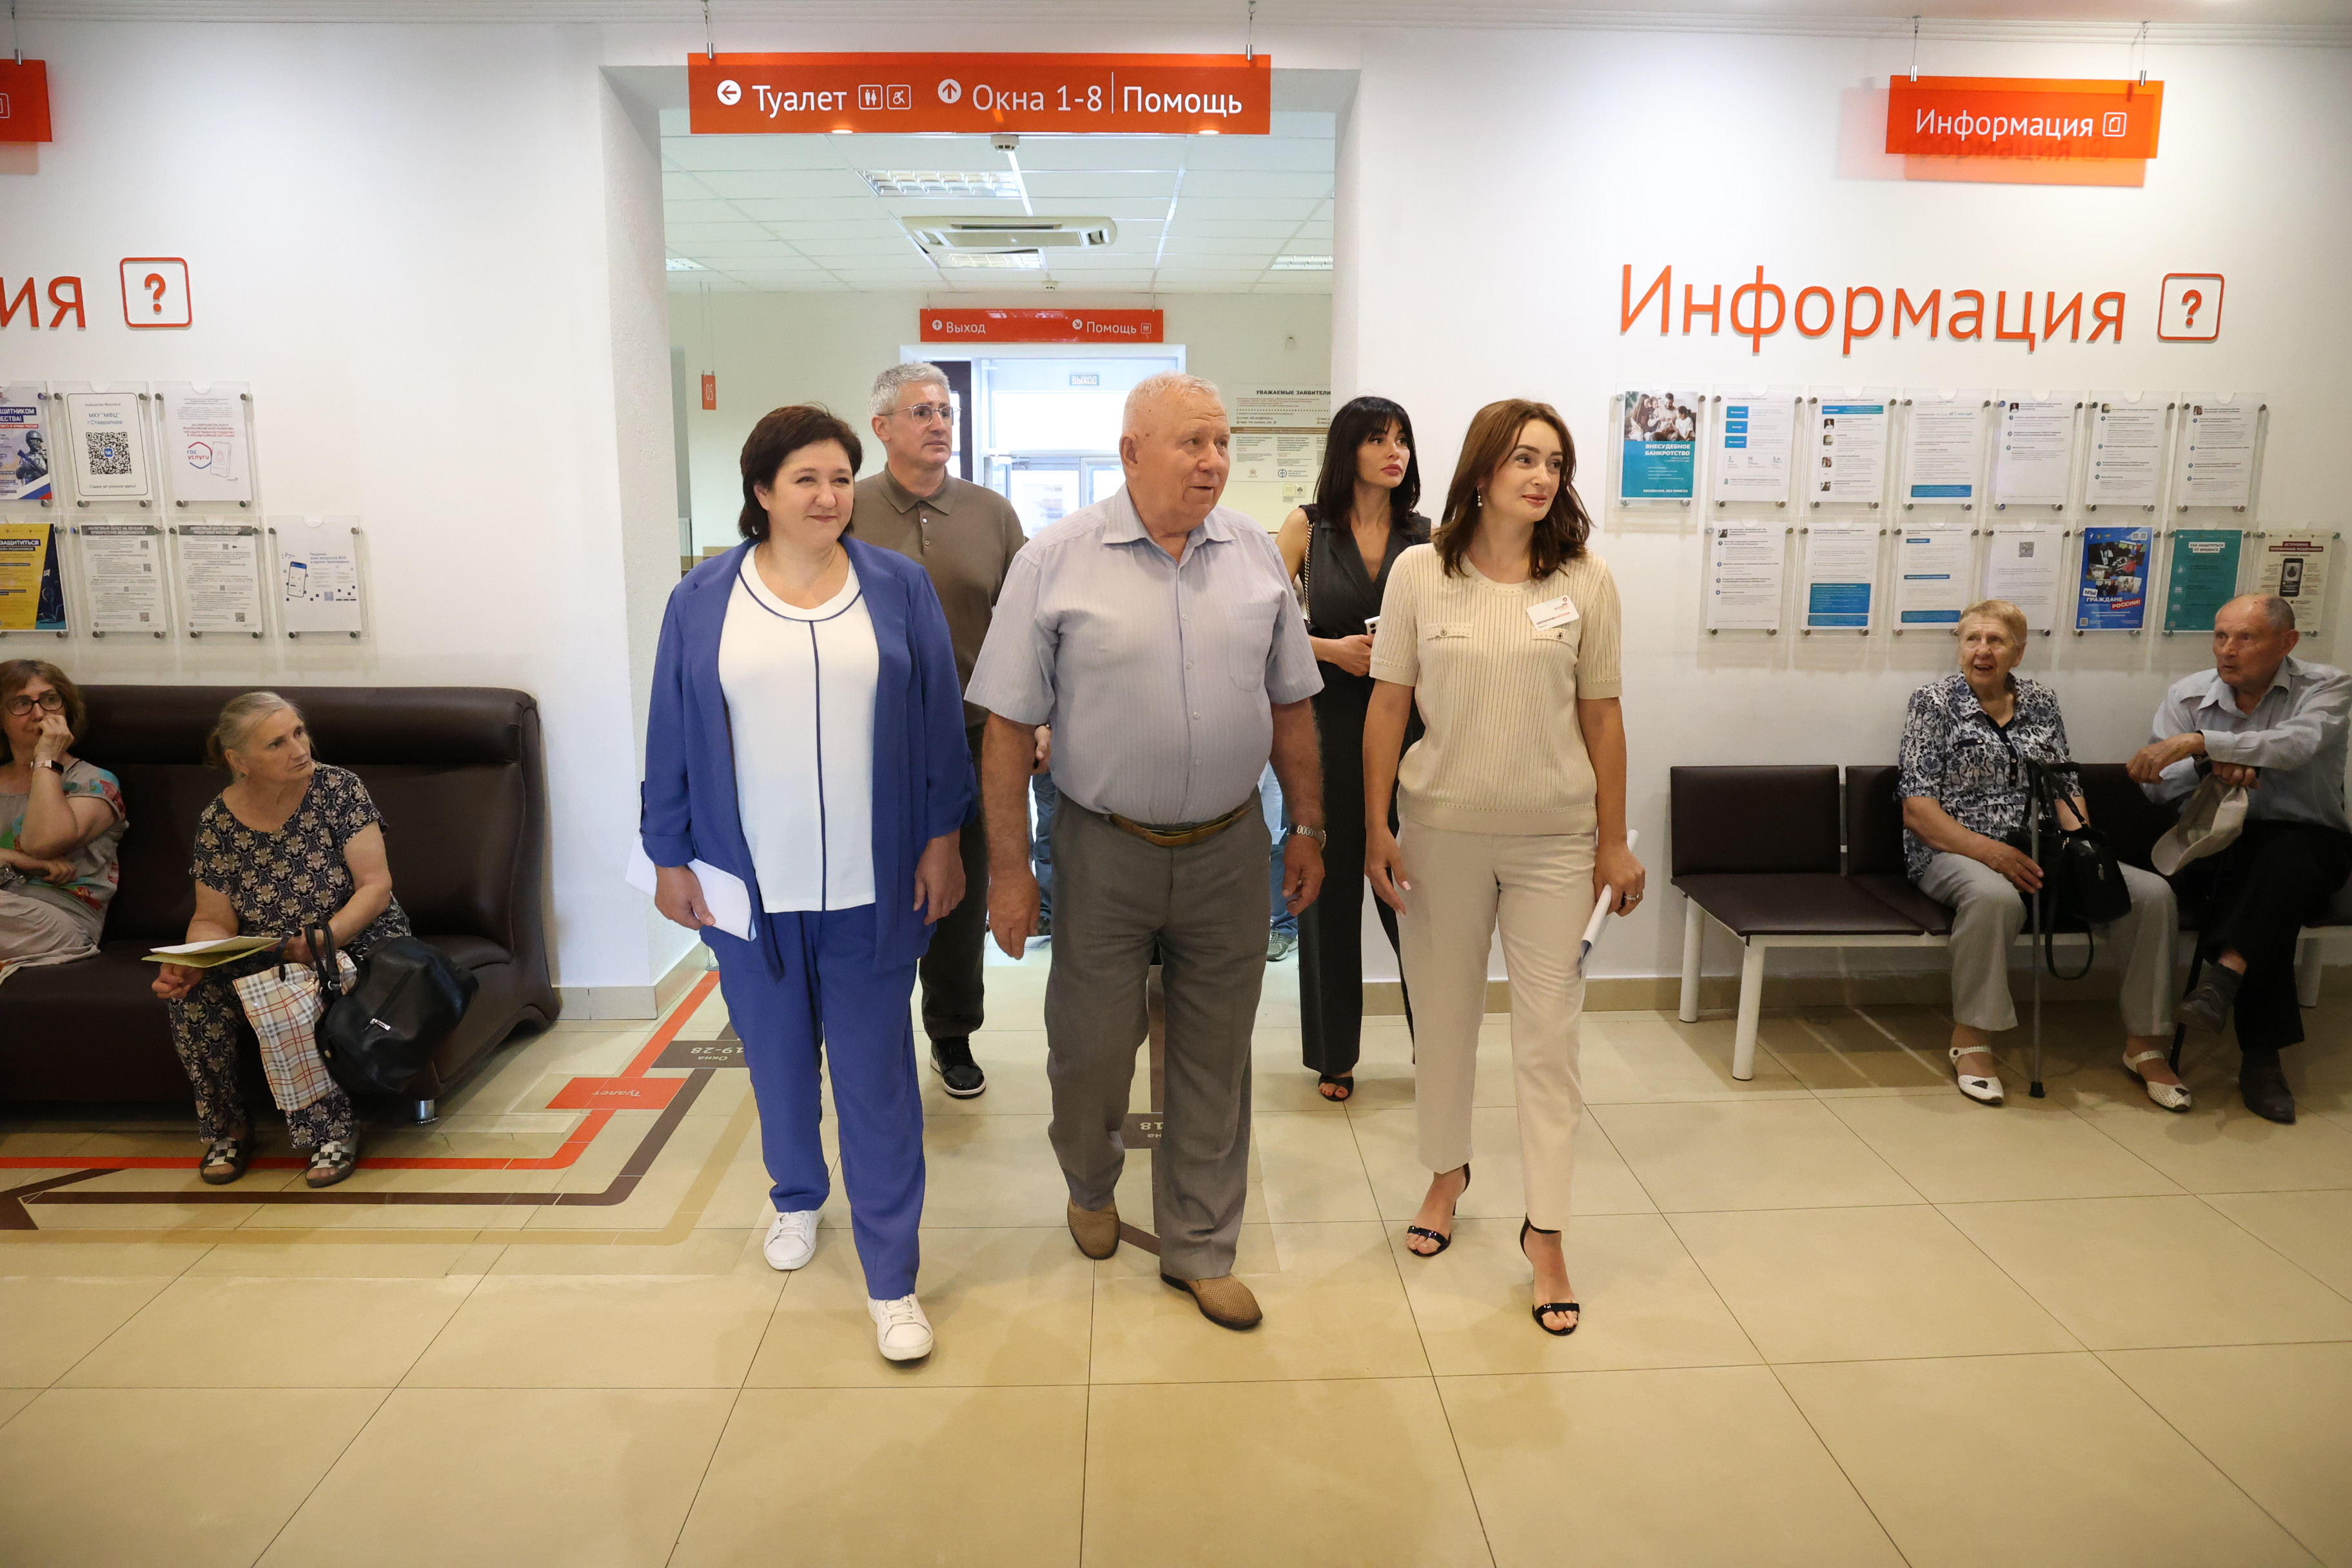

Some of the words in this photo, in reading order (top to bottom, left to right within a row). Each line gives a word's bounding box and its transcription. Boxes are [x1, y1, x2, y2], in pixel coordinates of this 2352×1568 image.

[752, 85, 847, 119] Туалет
[974, 85, 1044, 111] Окна
[1057, 85, 1102, 112] 1-8
[1124, 86, 1242, 118] Помощь
[1917, 108, 2093, 141] Информация
[0, 277, 86, 328] ия
[1622, 264, 2126, 355] Информация
[947, 322, 986, 334] Выход
[1087, 322, 1137, 335] Помощь
[1072, 376, 1097, 386] ВЫХОД
[2112, 600, 2141, 609] РОССИИ!
